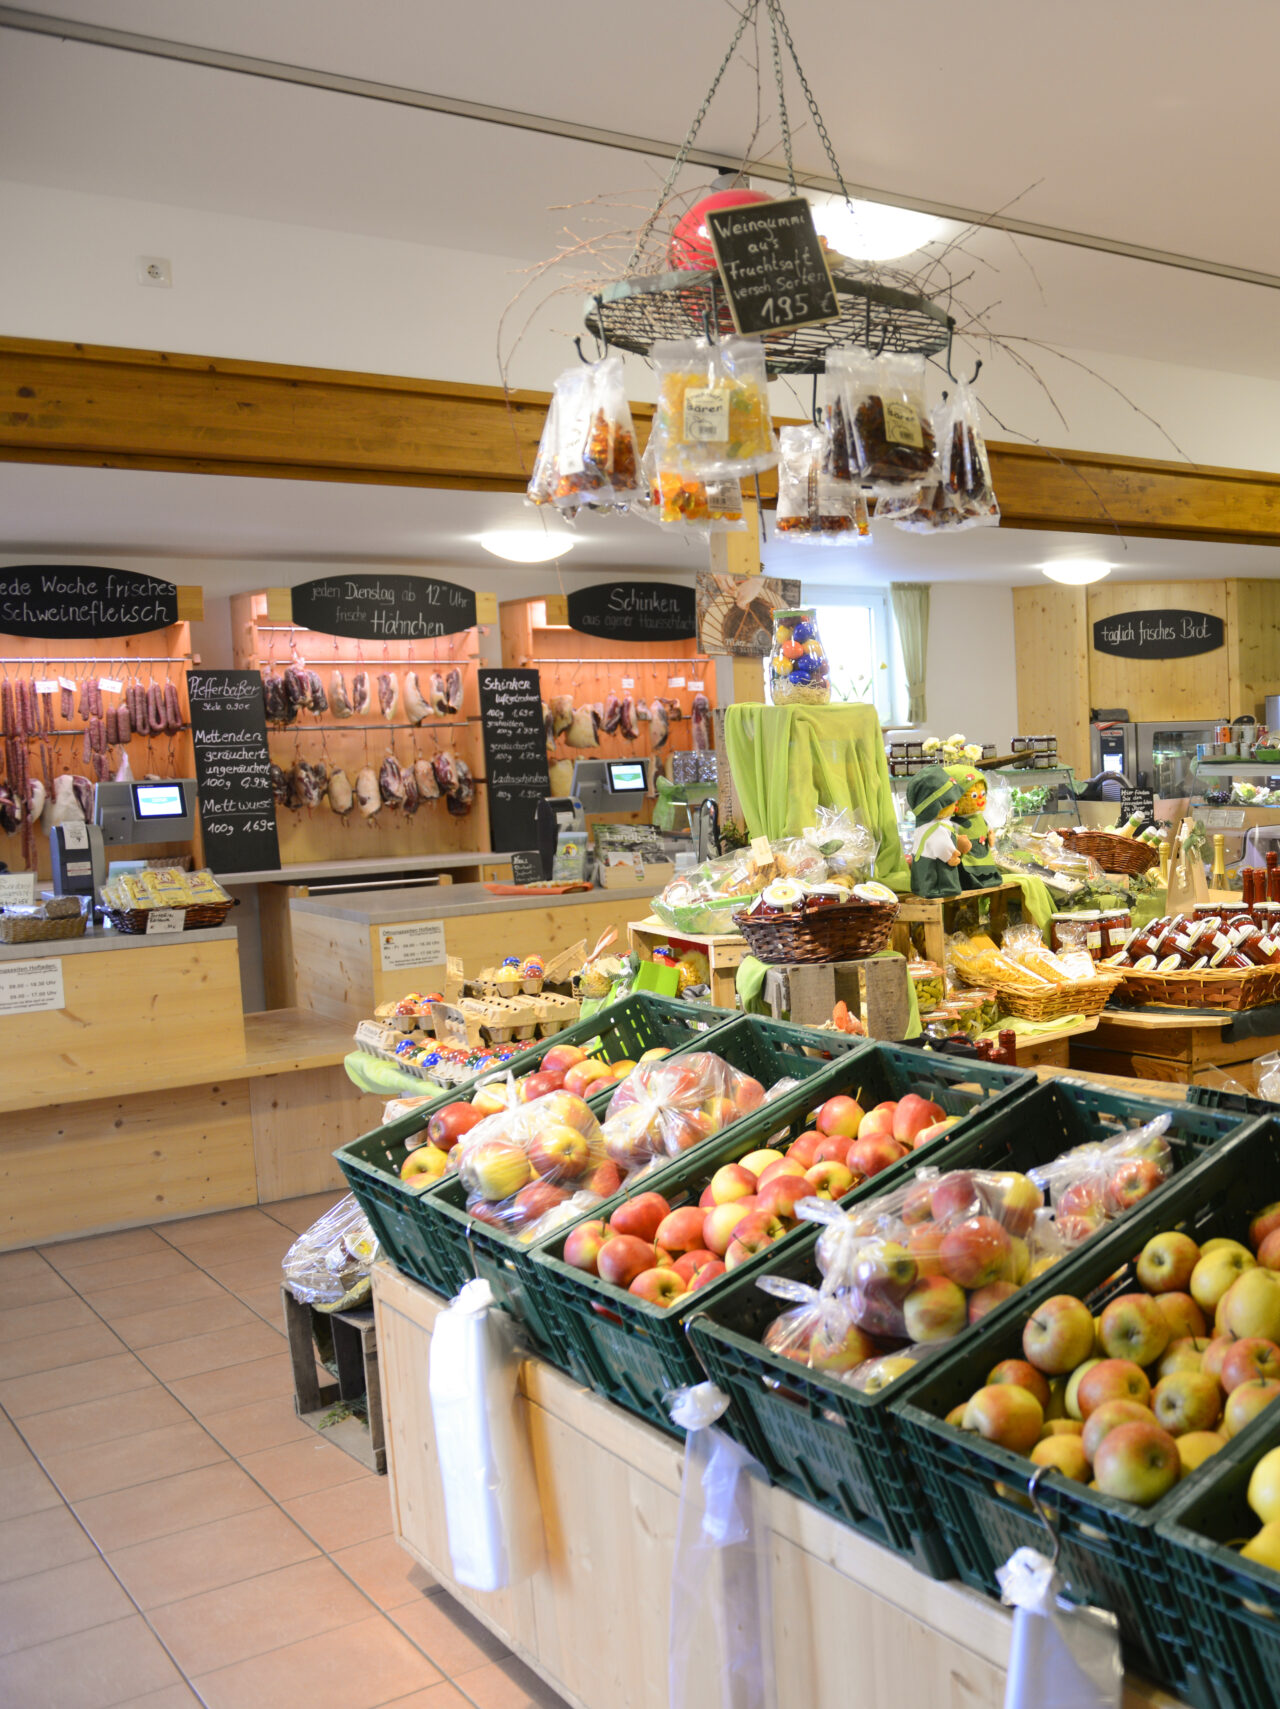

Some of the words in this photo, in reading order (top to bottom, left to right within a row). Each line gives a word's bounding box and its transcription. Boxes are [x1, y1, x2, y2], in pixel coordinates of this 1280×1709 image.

[713, 207, 806, 241] Weingummi
[747, 238, 780, 254] aus
[723, 246, 814, 281] Fruchtsaft
[776, 266, 826, 292] Sorten
[760, 293, 809, 325] 1,95
[820, 291, 835, 313] €
[41, 575, 99, 596] Woche
[105, 573, 178, 599] frisches
[310, 582, 342, 602] jeden
[344, 580, 396, 605] Dienstag
[400, 581, 417, 603] ab
[449, 588, 470, 608] Uhr
[1, 599, 171, 627] Schweinefleisch
[607, 587, 681, 613] Schinken
[335, 606, 368, 624] frische
[369, 609, 446, 637] Hähnchen
[582, 614, 601, 627] aus
[1100, 621, 1136, 646] täglich
[1138, 618, 1177, 646] frisches
[1179, 615, 1213, 639] Brot
[187, 675, 260, 700] Pfefferbeißer
[482, 677, 531, 691] Schinken
[194, 728, 263, 744] Mettenden
[203, 747, 269, 762] geräuchert
[205, 762, 271, 777] ungeräuchert
[201, 777, 232, 790] 100g
[207, 822, 235, 836] 100g
